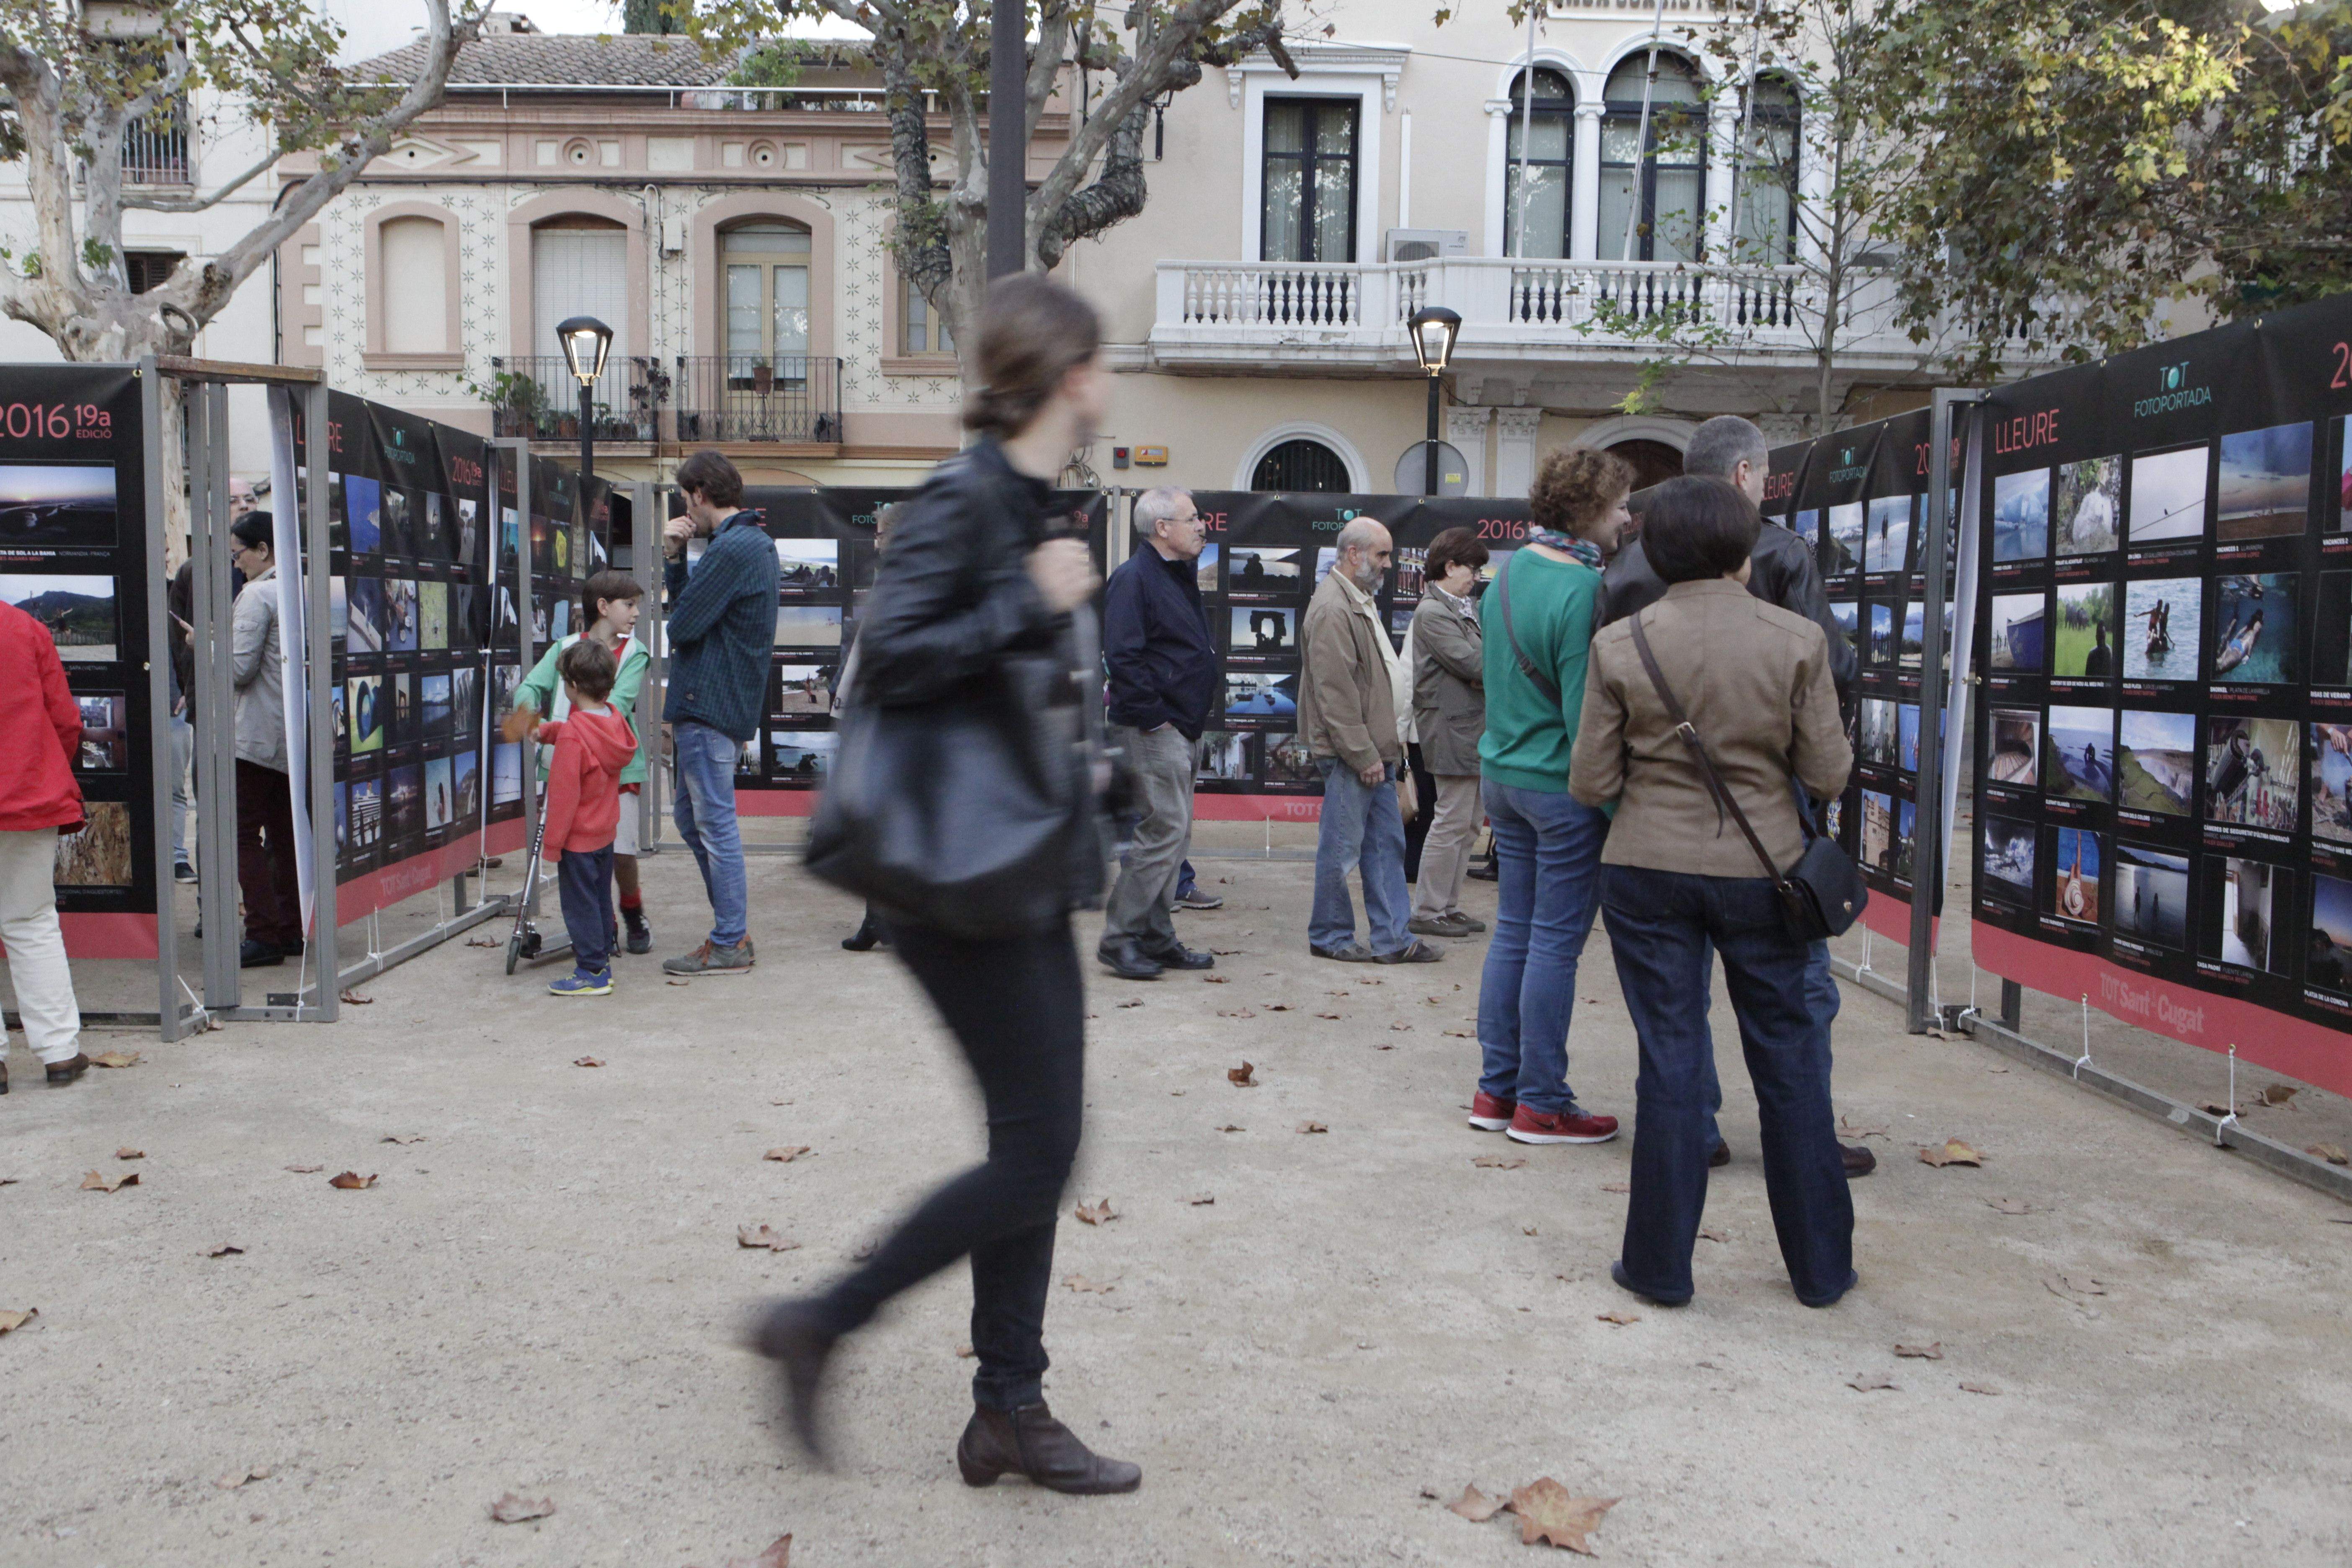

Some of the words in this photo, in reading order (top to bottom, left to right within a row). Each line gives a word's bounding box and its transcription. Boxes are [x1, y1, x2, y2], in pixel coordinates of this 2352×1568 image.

[2160, 361, 2190, 391] TOT
[2134, 386, 2212, 417] FOTOPORTADA
[0, 403, 70, 438] 016
[74, 404, 111, 427] 19a
[1996, 409, 2059, 454] LLEURE
[76, 429, 112, 439] EDICIÓ
[1841, 446, 1855, 465] TOT
[1762, 472, 1794, 500] LEURE
[1335, 508, 1363, 521] TOT
[1477, 519, 1525, 540] 2016
[1284, 802, 1315, 816] TOT
[2197, 960, 2207, 969] CASA
[2100, 972, 2120, 1004] TOT
[2120, 982, 2150, 1016] Sant
[2158, 994, 2205, 1034] Cugat
